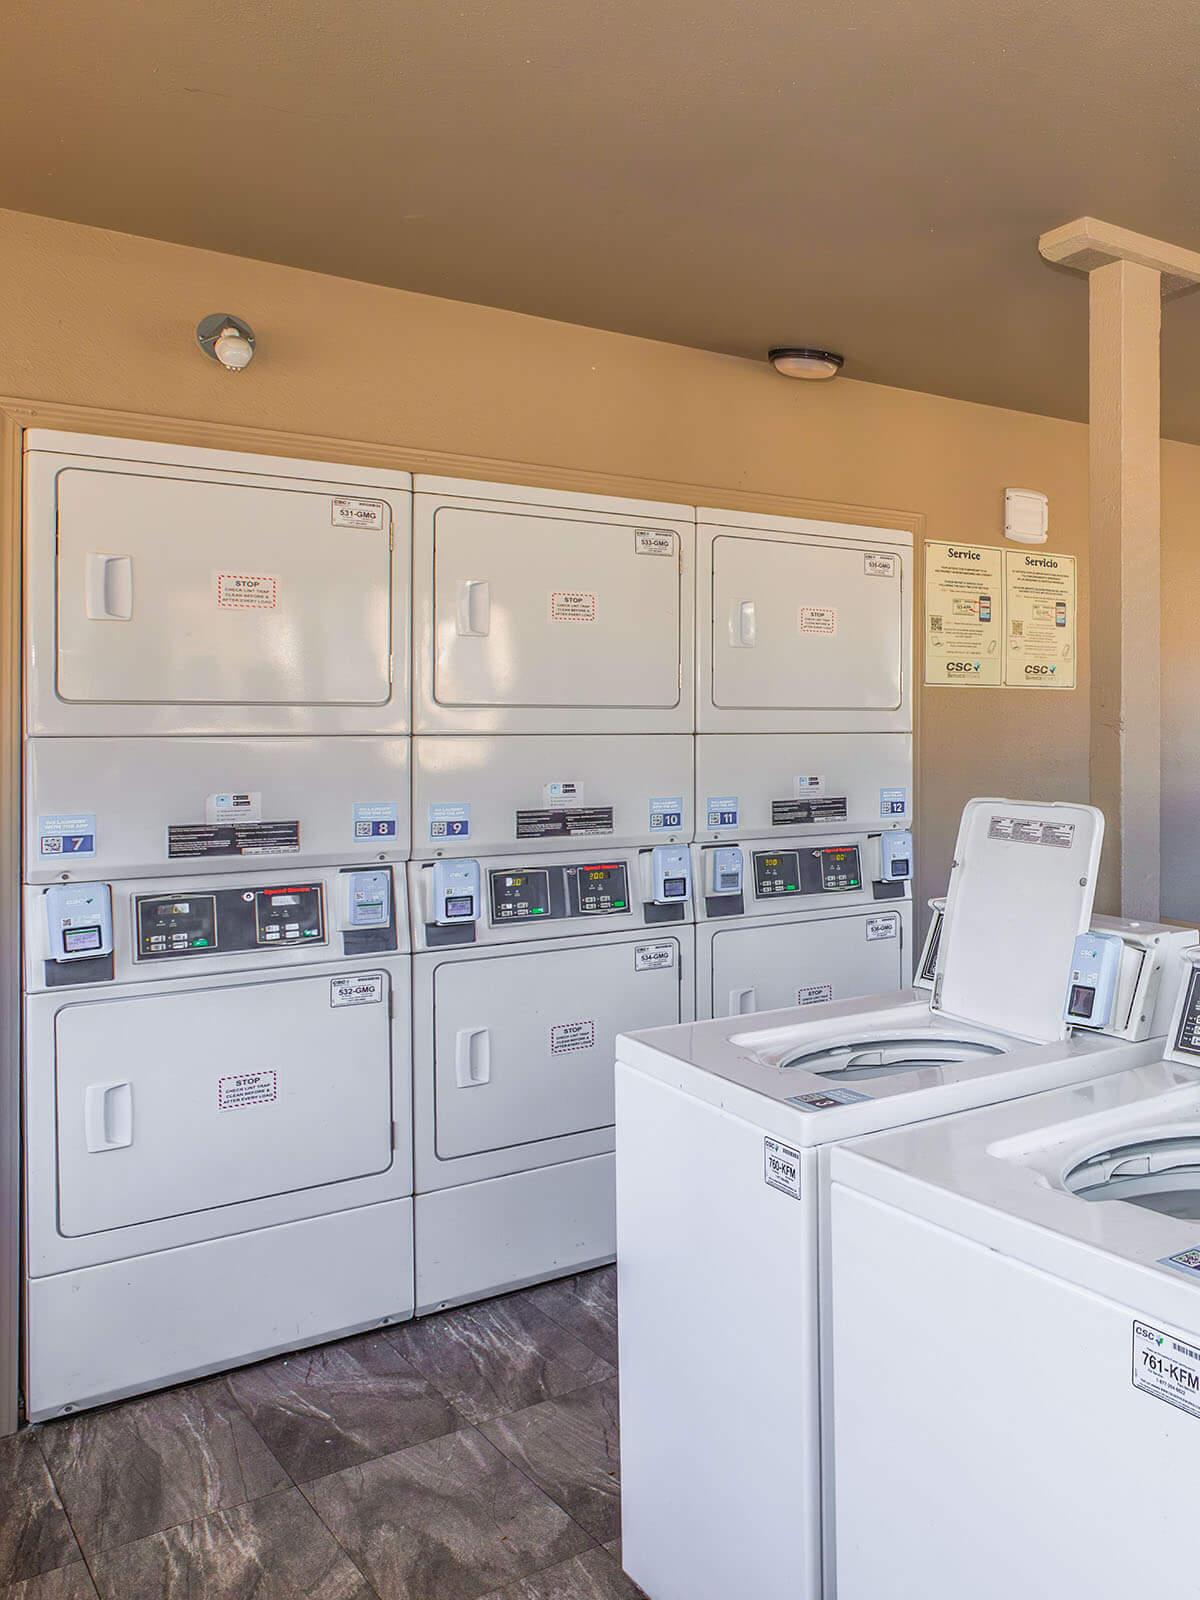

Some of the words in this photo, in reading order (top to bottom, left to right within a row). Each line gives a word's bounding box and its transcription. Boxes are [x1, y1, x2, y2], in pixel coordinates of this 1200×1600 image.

[340, 509, 376, 519] 531-GMG
[641, 539, 669, 547] 533-GMG
[948, 548, 981, 561] Service
[1025, 556, 1058, 569] Servicio
[946, 662, 973, 672] CSC
[1024, 665, 1049, 674] CSC
[893, 803, 903, 812] 12
[665, 815, 678, 825] 10
[723, 813, 733, 824] 11
[379, 823, 388, 834] 8
[453, 823, 462, 834] 9
[72, 837, 84, 851] 7
[641, 952, 669, 961] 534-GMG
[338, 985, 376, 996] 532-GMG
[769, 1157, 796, 1179] 760-KFM
[1136, 1327, 1155, 1341] CSC
[1142, 1350, 1200, 1391] 761-KFM
